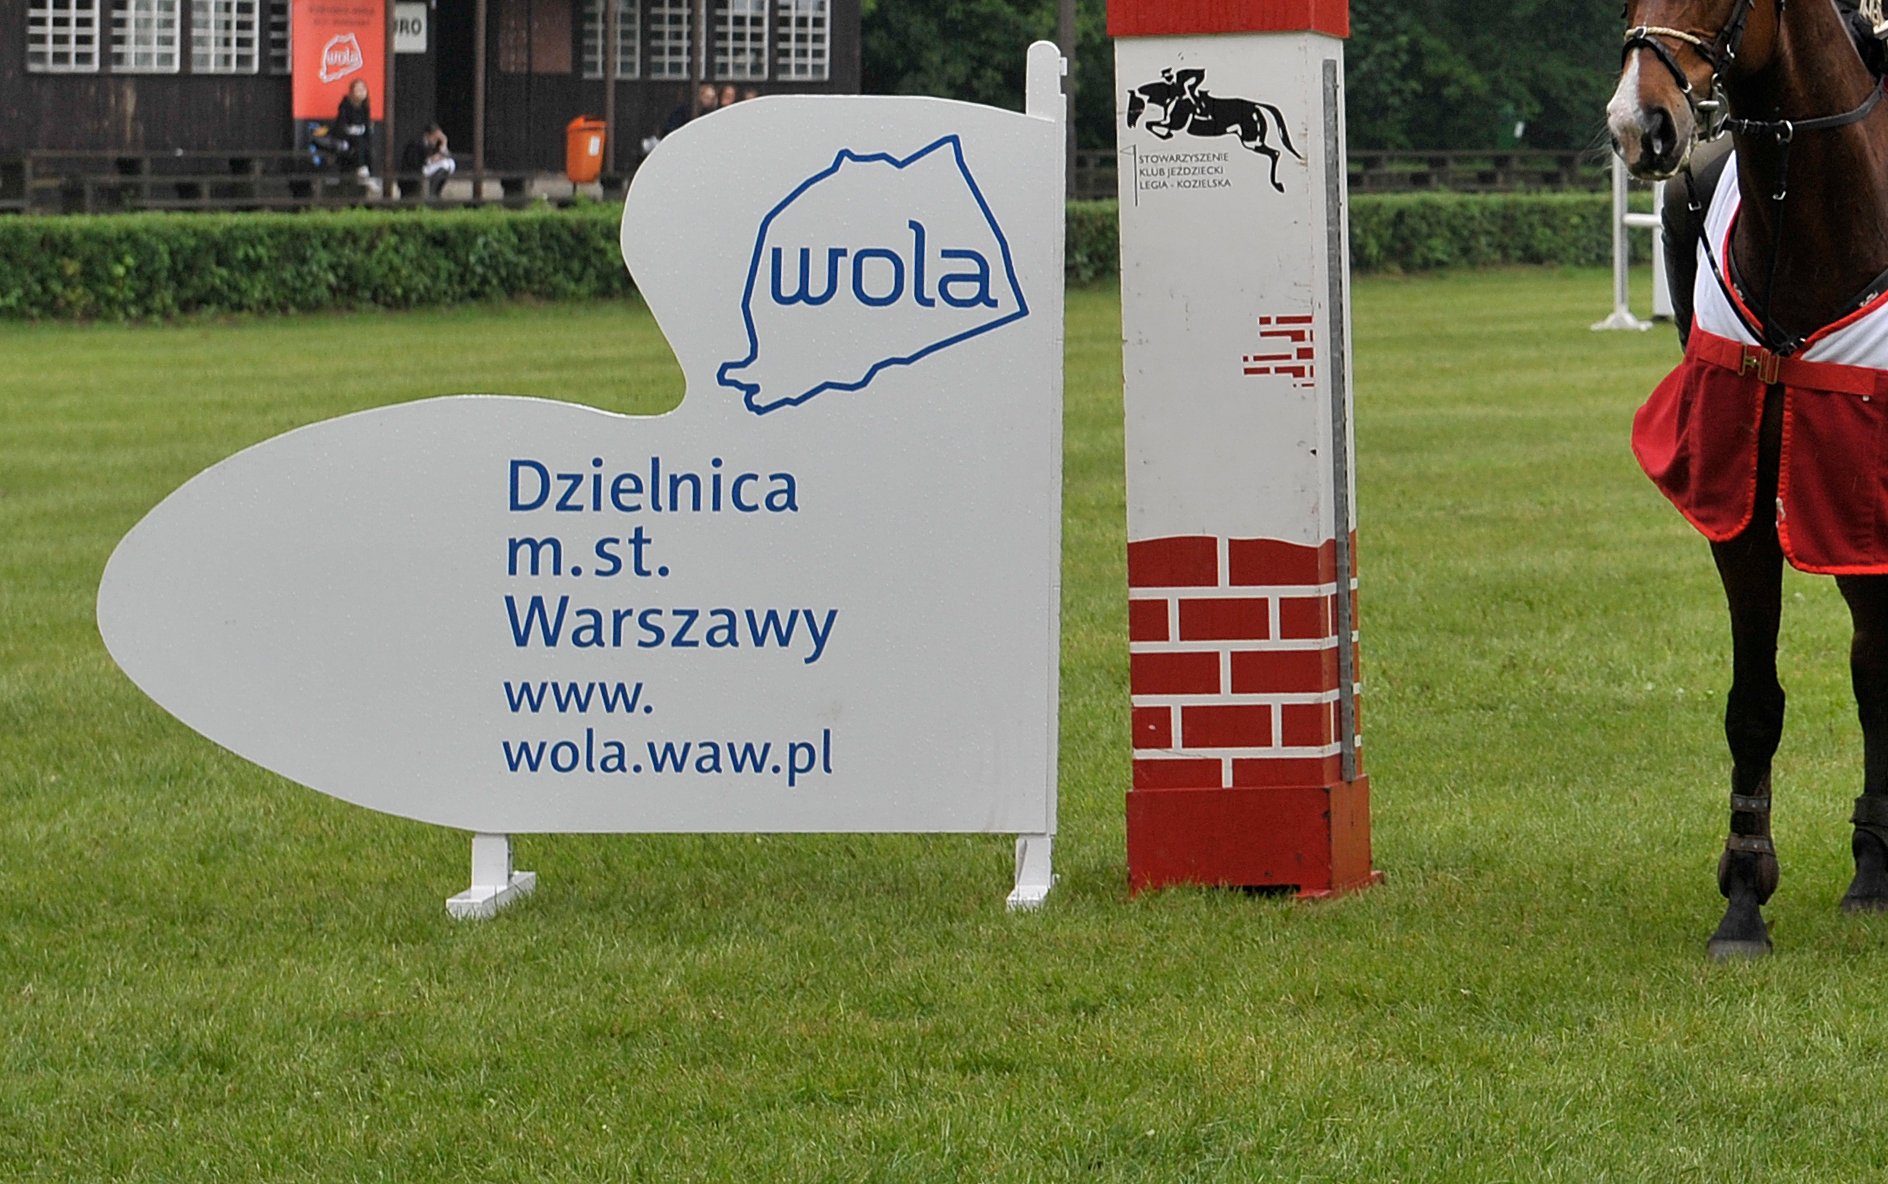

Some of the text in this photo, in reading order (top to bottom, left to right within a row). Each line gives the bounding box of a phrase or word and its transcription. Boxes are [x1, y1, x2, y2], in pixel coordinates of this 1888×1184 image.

[1138, 152, 1230, 165] STOWARZYSZENIE
[1139, 167, 1166, 177] KLUB
[1139, 180, 1169, 190] LEGIA
[1177, 178, 1232, 189] KOZIELSKA
[771, 220, 999, 308] wola
[508, 456, 800, 513] Dzielnica
[504, 595, 838, 665] Warszawy
[503, 681, 654, 714] www.
[502, 728, 833, 787] wola.waw.pl
